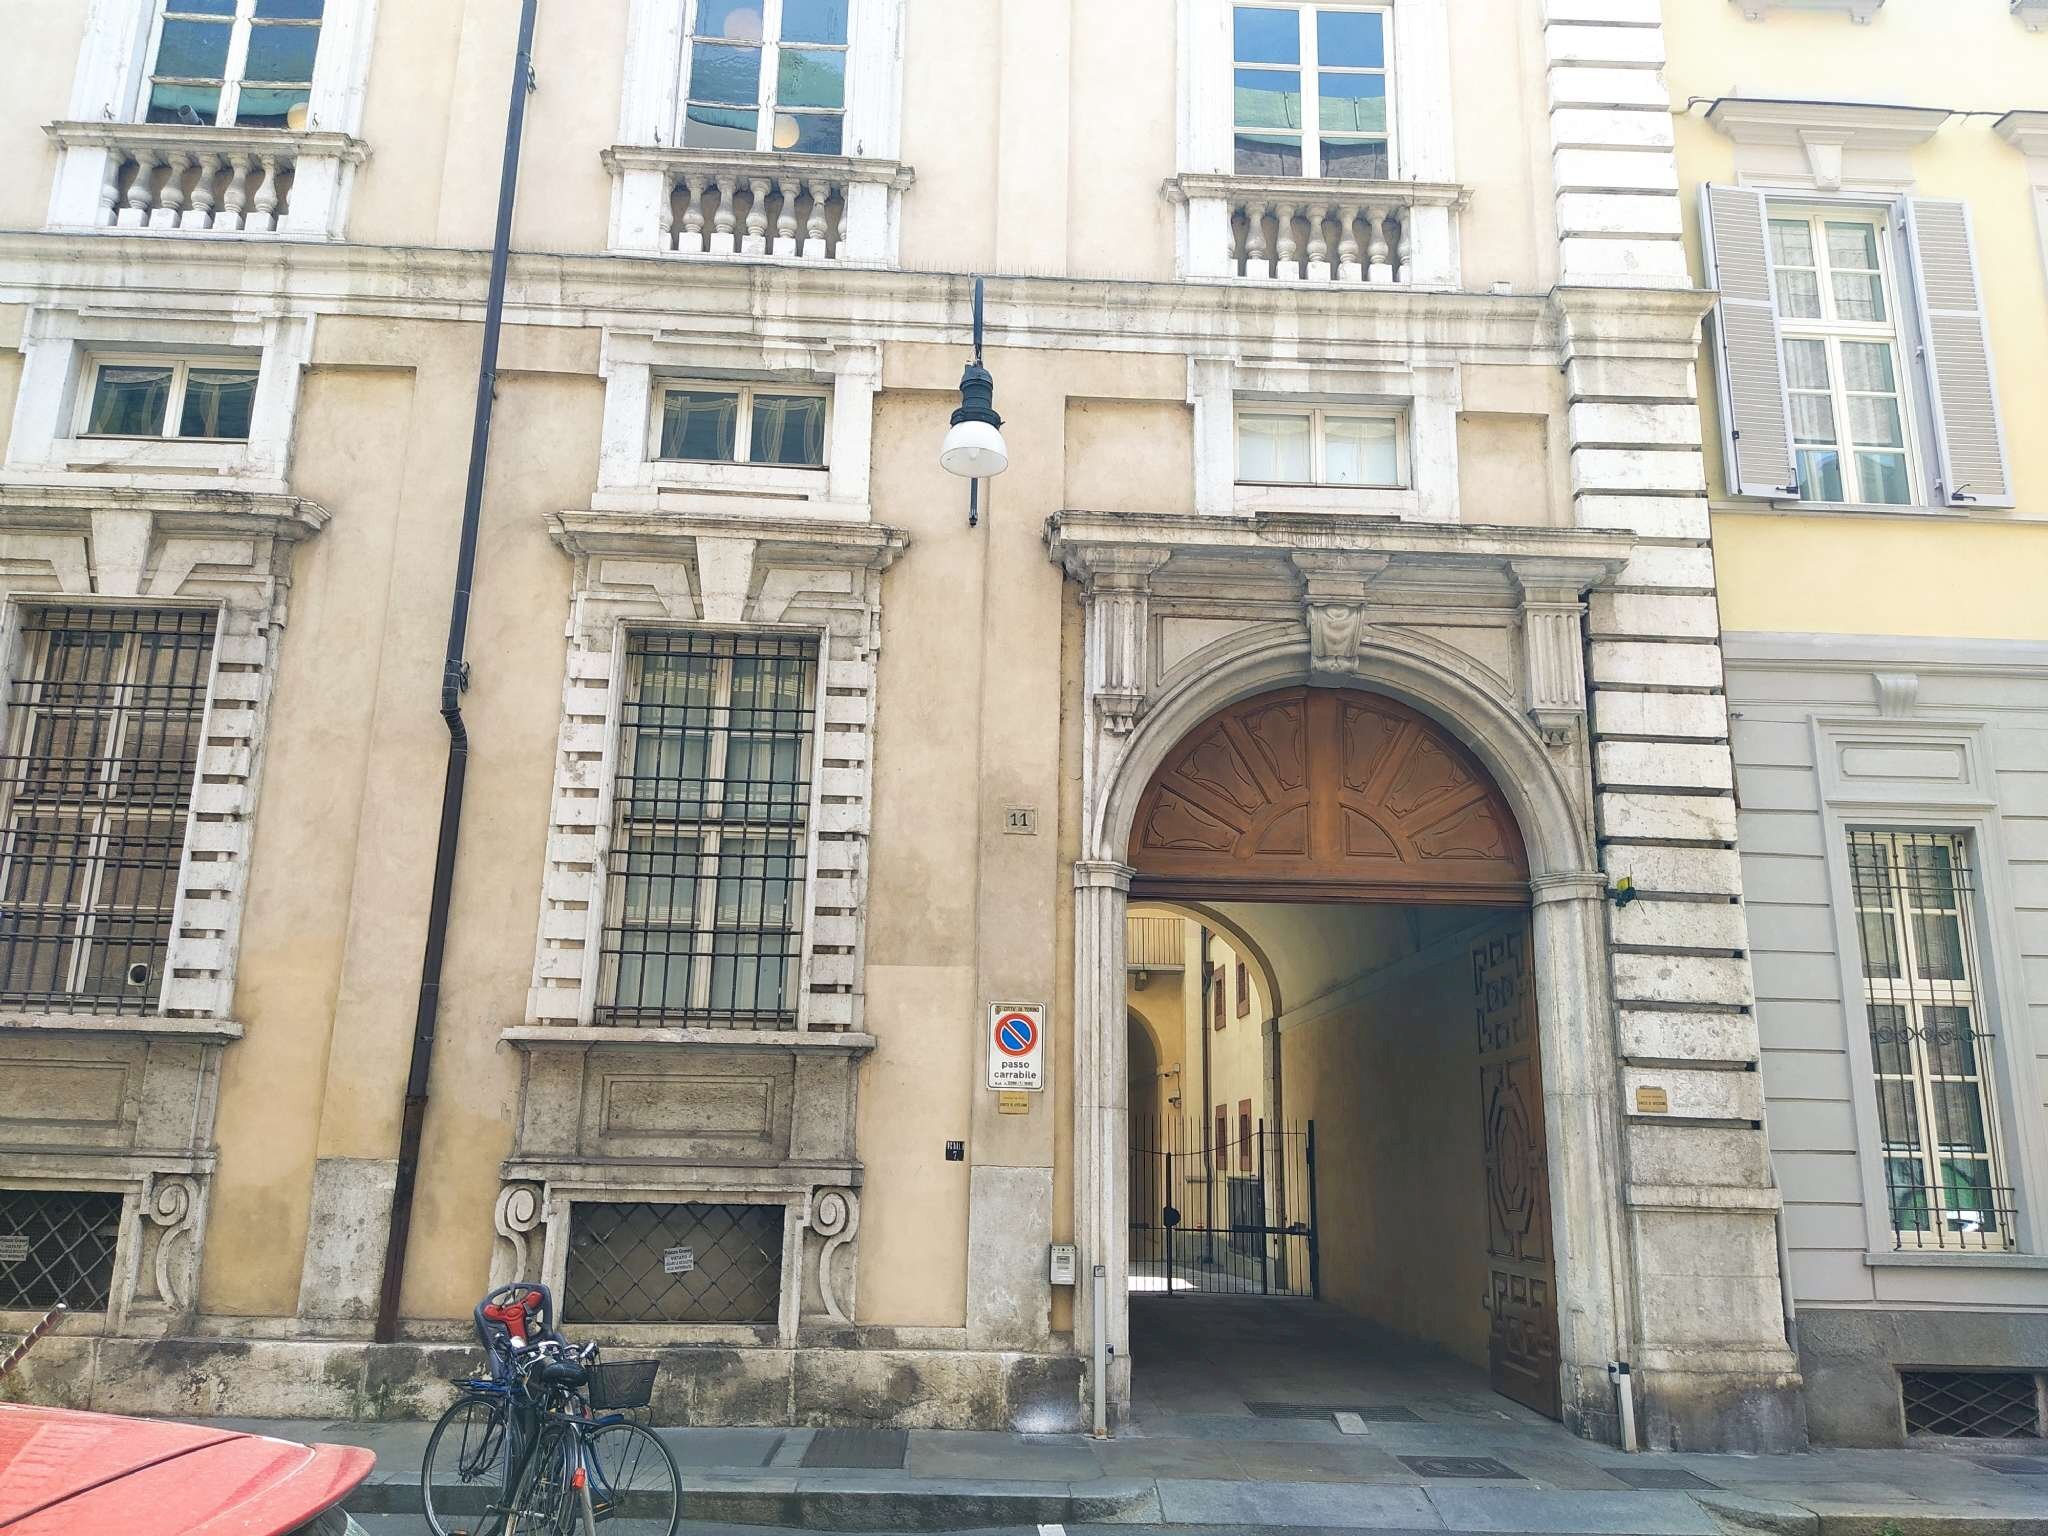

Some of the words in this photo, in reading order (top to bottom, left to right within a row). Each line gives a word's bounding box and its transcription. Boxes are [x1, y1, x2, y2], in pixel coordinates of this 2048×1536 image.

[1010, 812, 1028, 827] 11
[1001, 1061, 1030, 1070] passo
[993, 1070, 1037, 1079] carrabile
